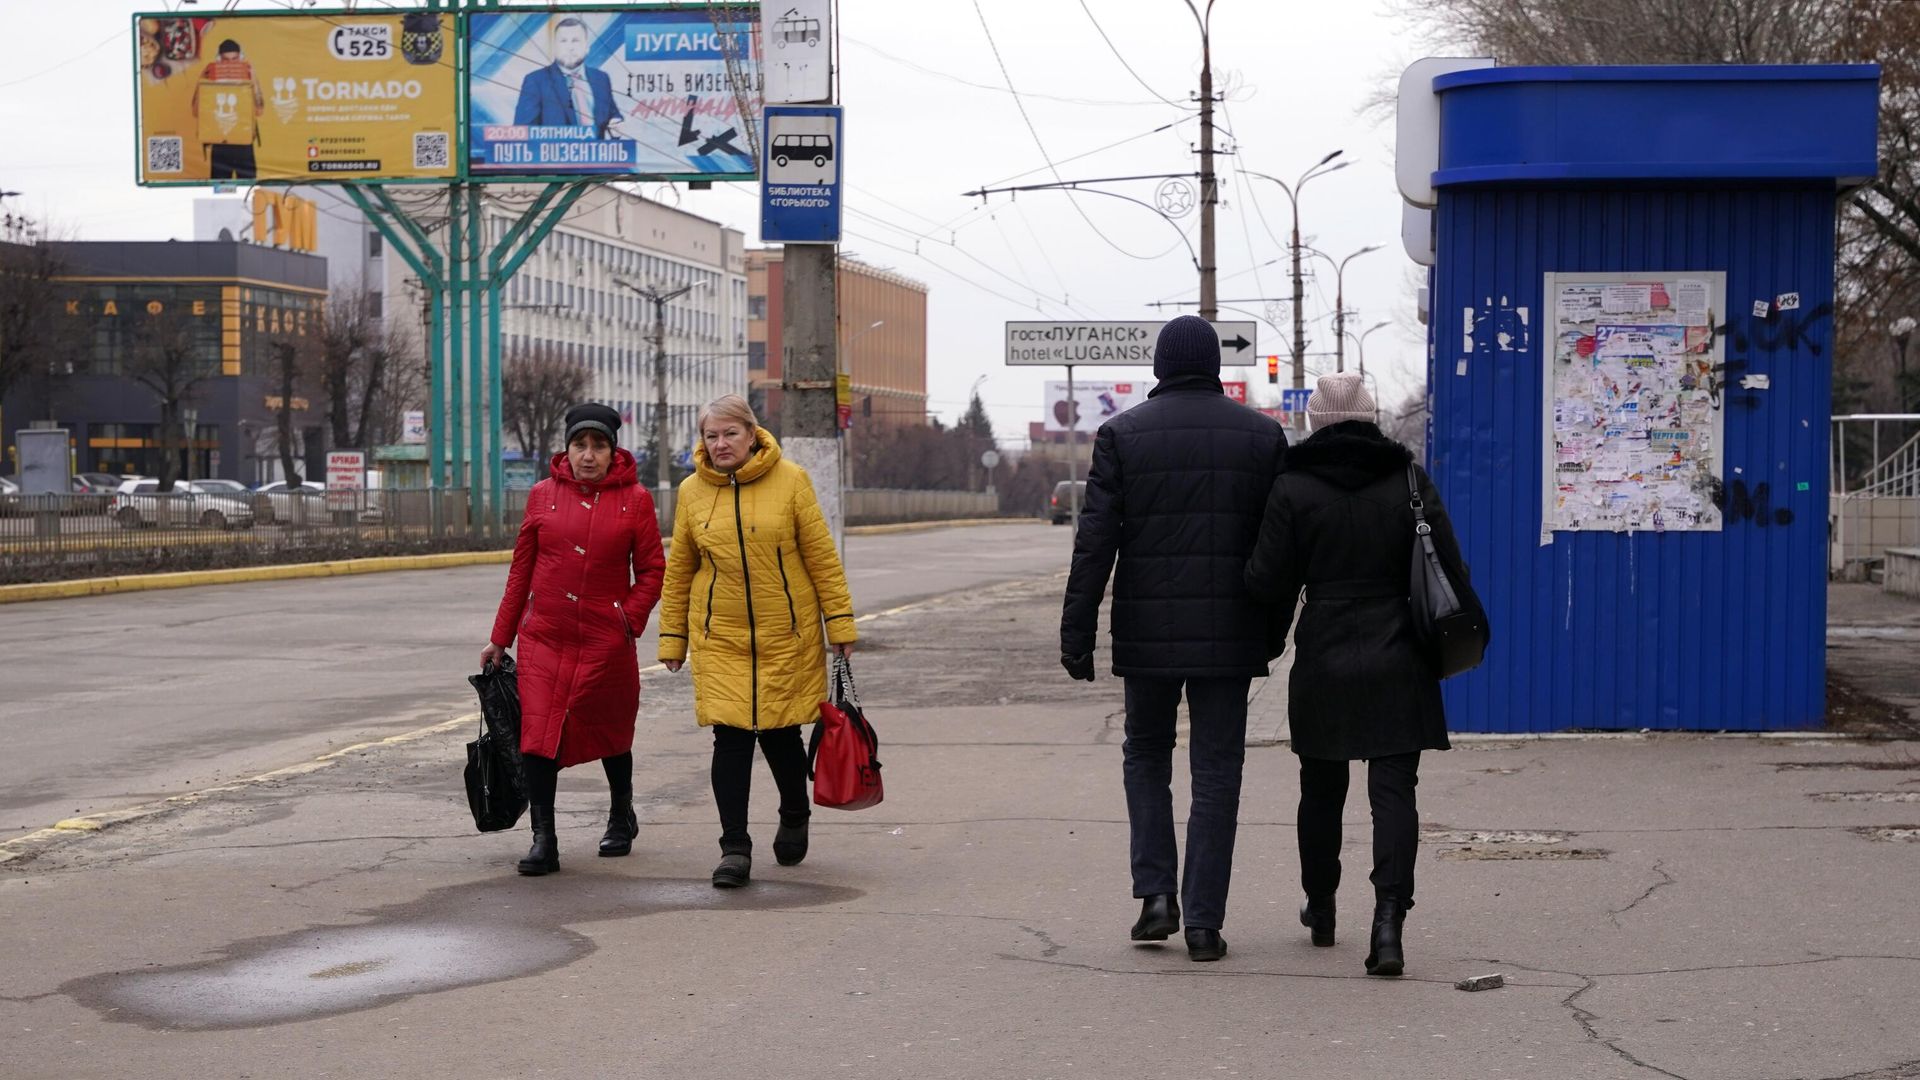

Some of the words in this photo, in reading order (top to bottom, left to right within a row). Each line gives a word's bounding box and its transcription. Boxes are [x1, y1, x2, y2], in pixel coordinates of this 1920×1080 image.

[350, 27, 387, 36] ТАКСИ
[350, 40, 388, 57] 525
[636, 73, 674, 93] ПУТЬ
[487, 127, 526, 140] 20:00
[530, 126, 595, 140] ПЯТНИЦА
[494, 142, 533, 162] ПУТЬ
[540, 142, 629, 162] ВИЗЕНТАЛЬ
[768, 187, 831, 196] БИБЛИОТЕКА
[1597, 327, 1616, 341] 27
[1011, 346, 1051, 361] hotel
